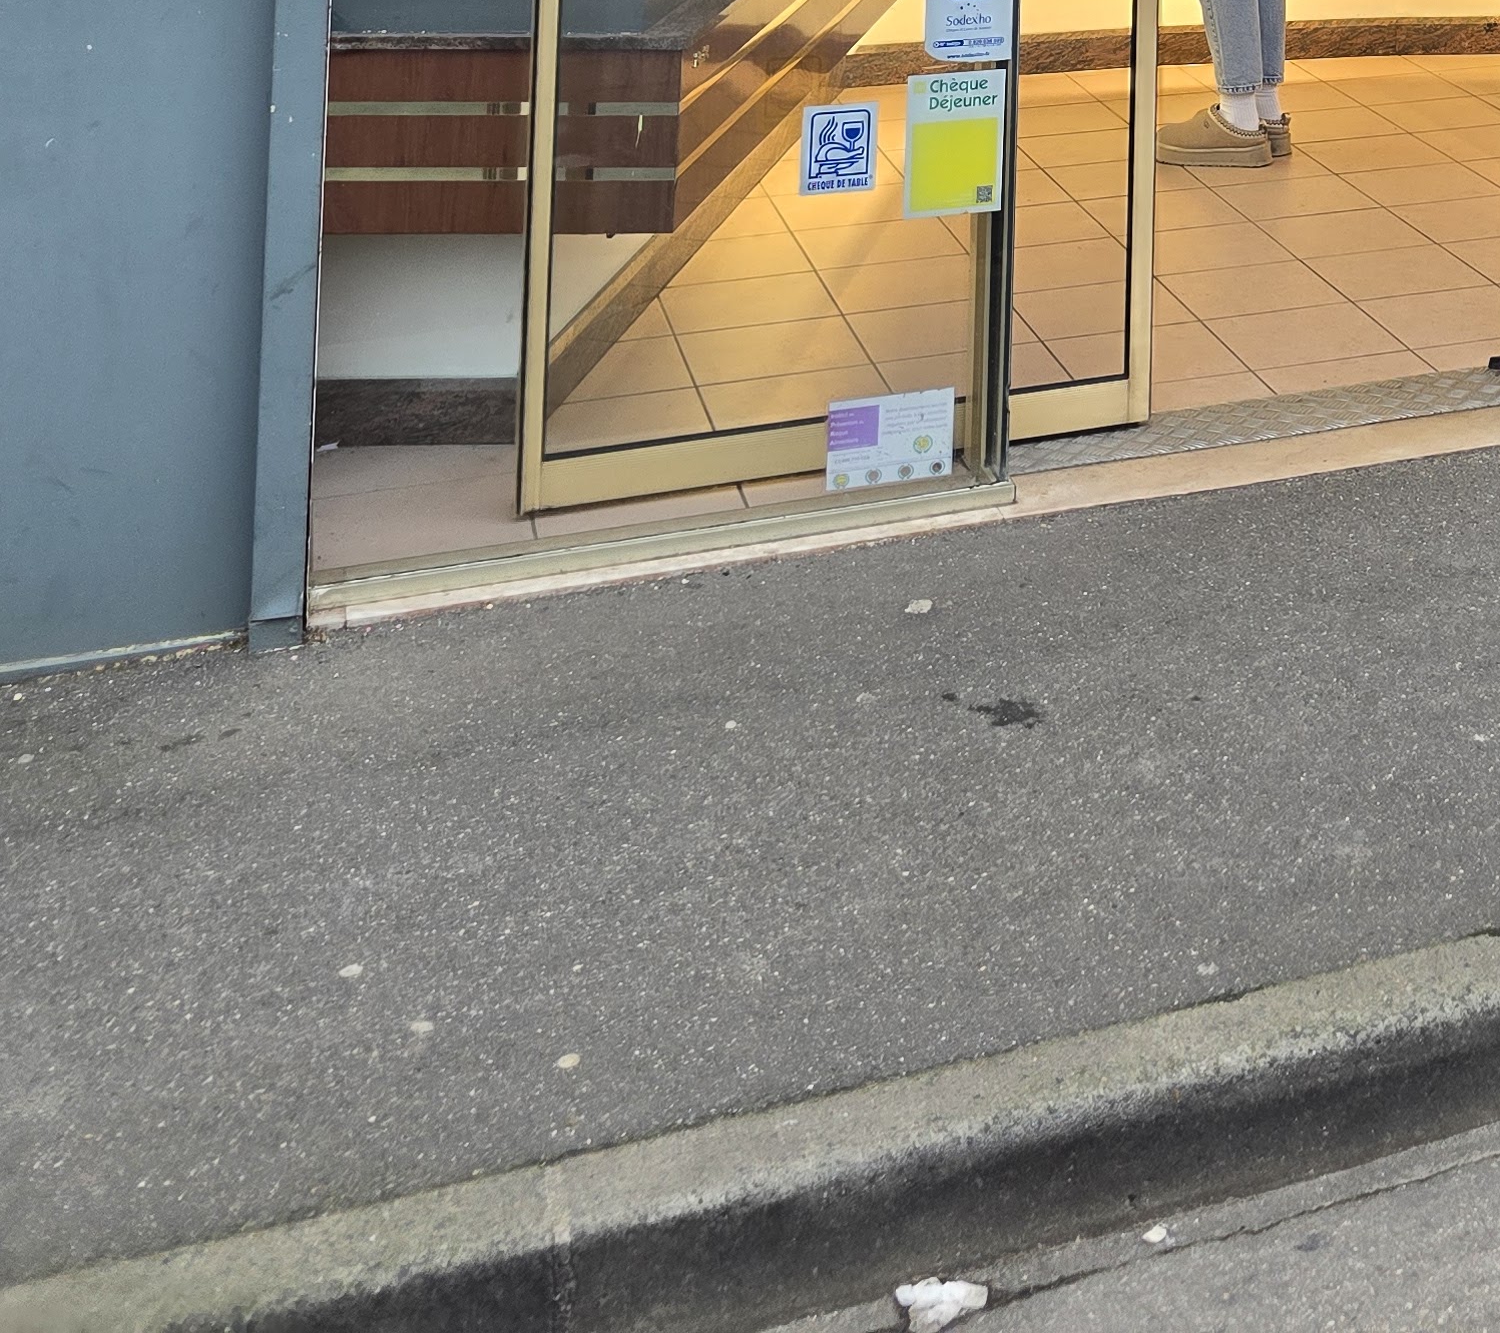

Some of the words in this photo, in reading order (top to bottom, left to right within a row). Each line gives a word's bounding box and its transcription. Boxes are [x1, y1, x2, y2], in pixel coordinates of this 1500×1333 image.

[945, 13, 992, 26] Sodexho
[929, 78, 989, 95] Chèque
[928, 94, 999, 112] Déjeuner
[836, 178, 846, 188] DE
[847, 176, 869, 188] TABLE
